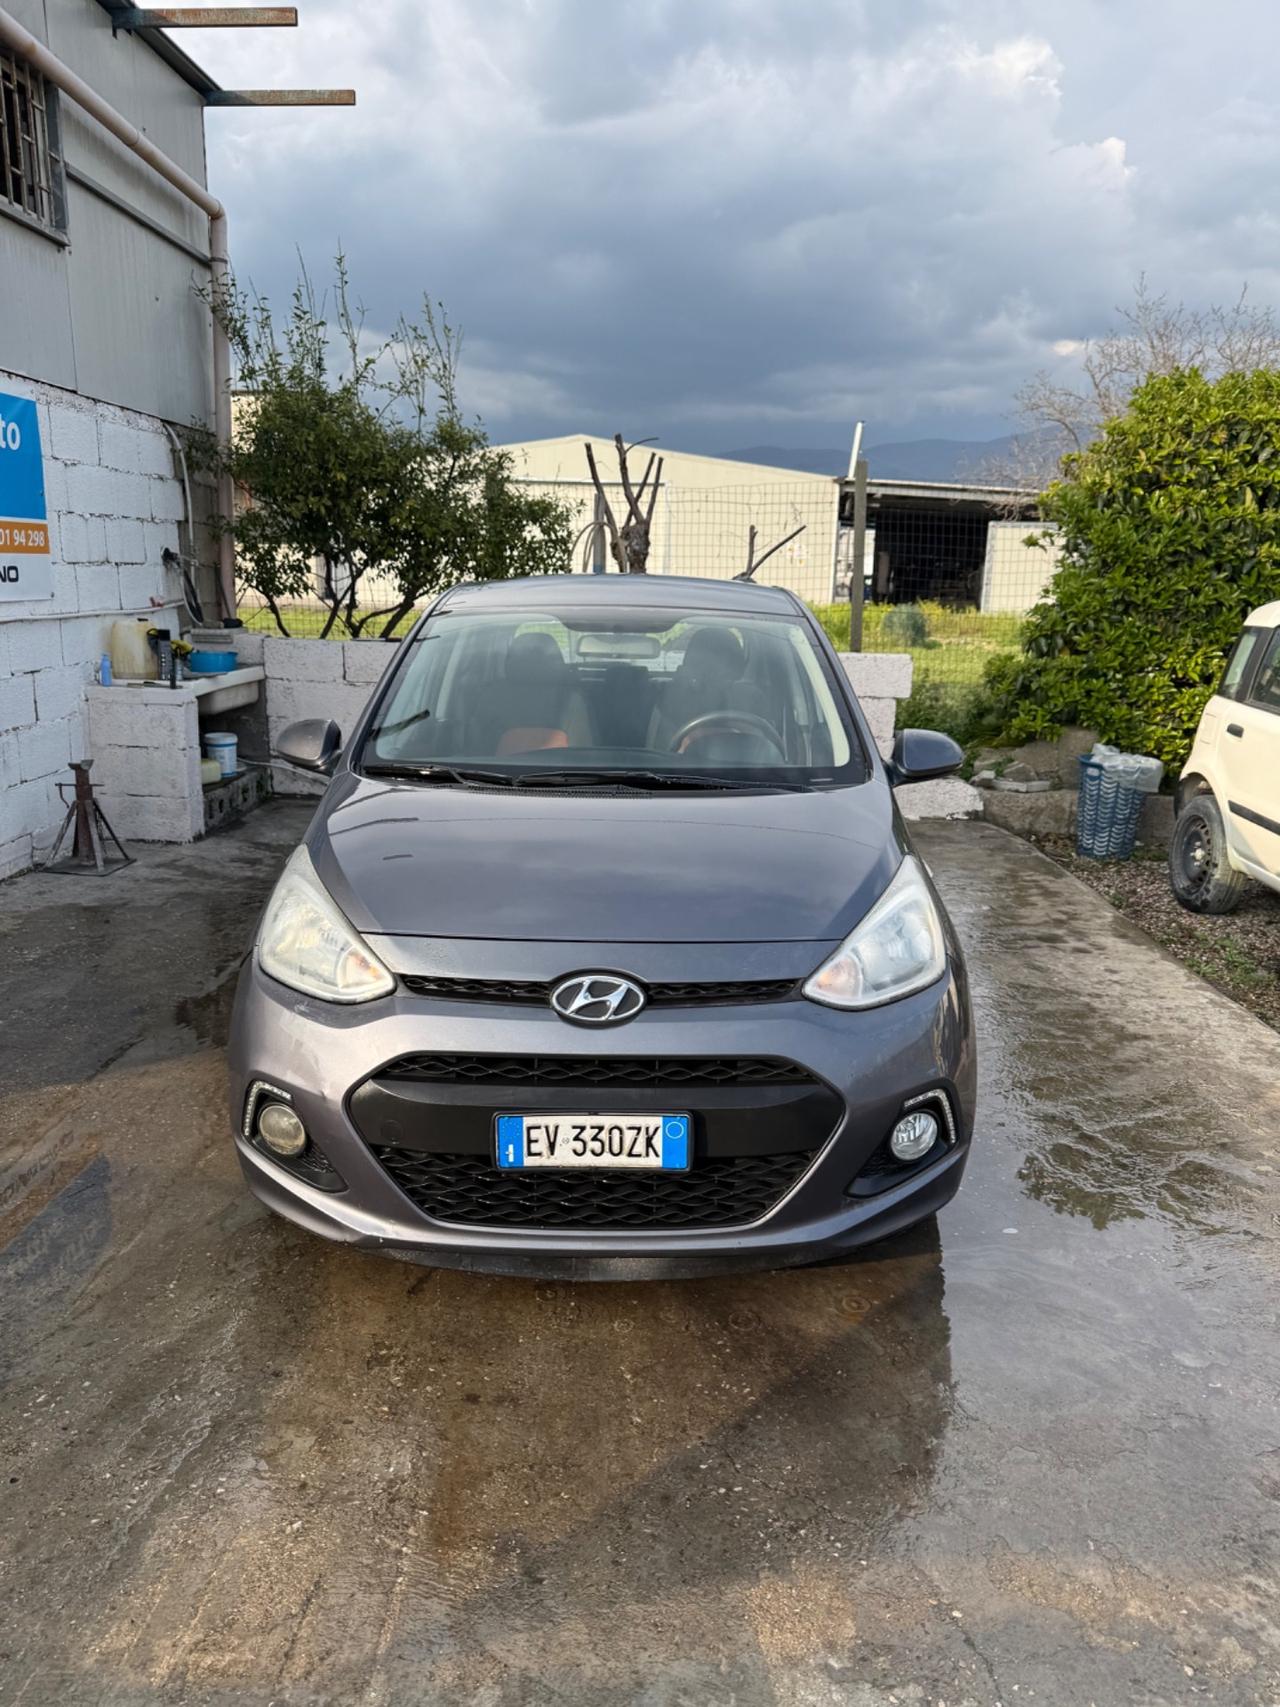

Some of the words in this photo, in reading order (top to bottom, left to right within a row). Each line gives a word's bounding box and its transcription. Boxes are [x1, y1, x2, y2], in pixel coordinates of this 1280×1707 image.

[13, 529, 26, 546] 94
[27, 529, 45, 547] 298
[526, 1124, 560, 1158] EV
[571, 1124, 661, 1158] 330ZK
